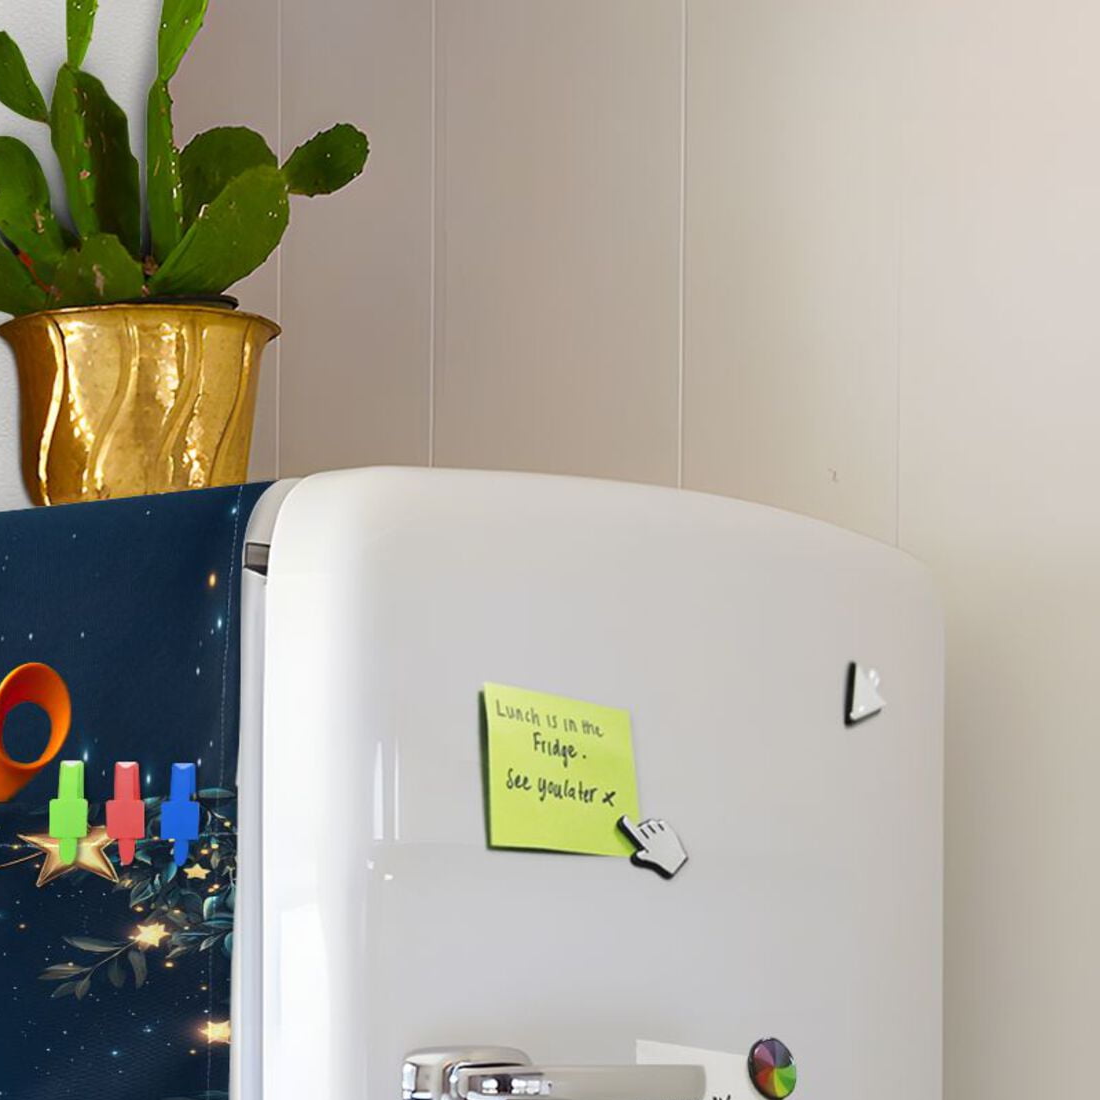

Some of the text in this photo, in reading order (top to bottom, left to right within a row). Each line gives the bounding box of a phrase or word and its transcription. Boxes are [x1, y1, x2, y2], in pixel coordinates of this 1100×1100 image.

[496, 699, 541, 728] Lunch
[564, 718, 578, 733] in
[582, 719, 604, 738] the
[506, 768, 532, 790] See
